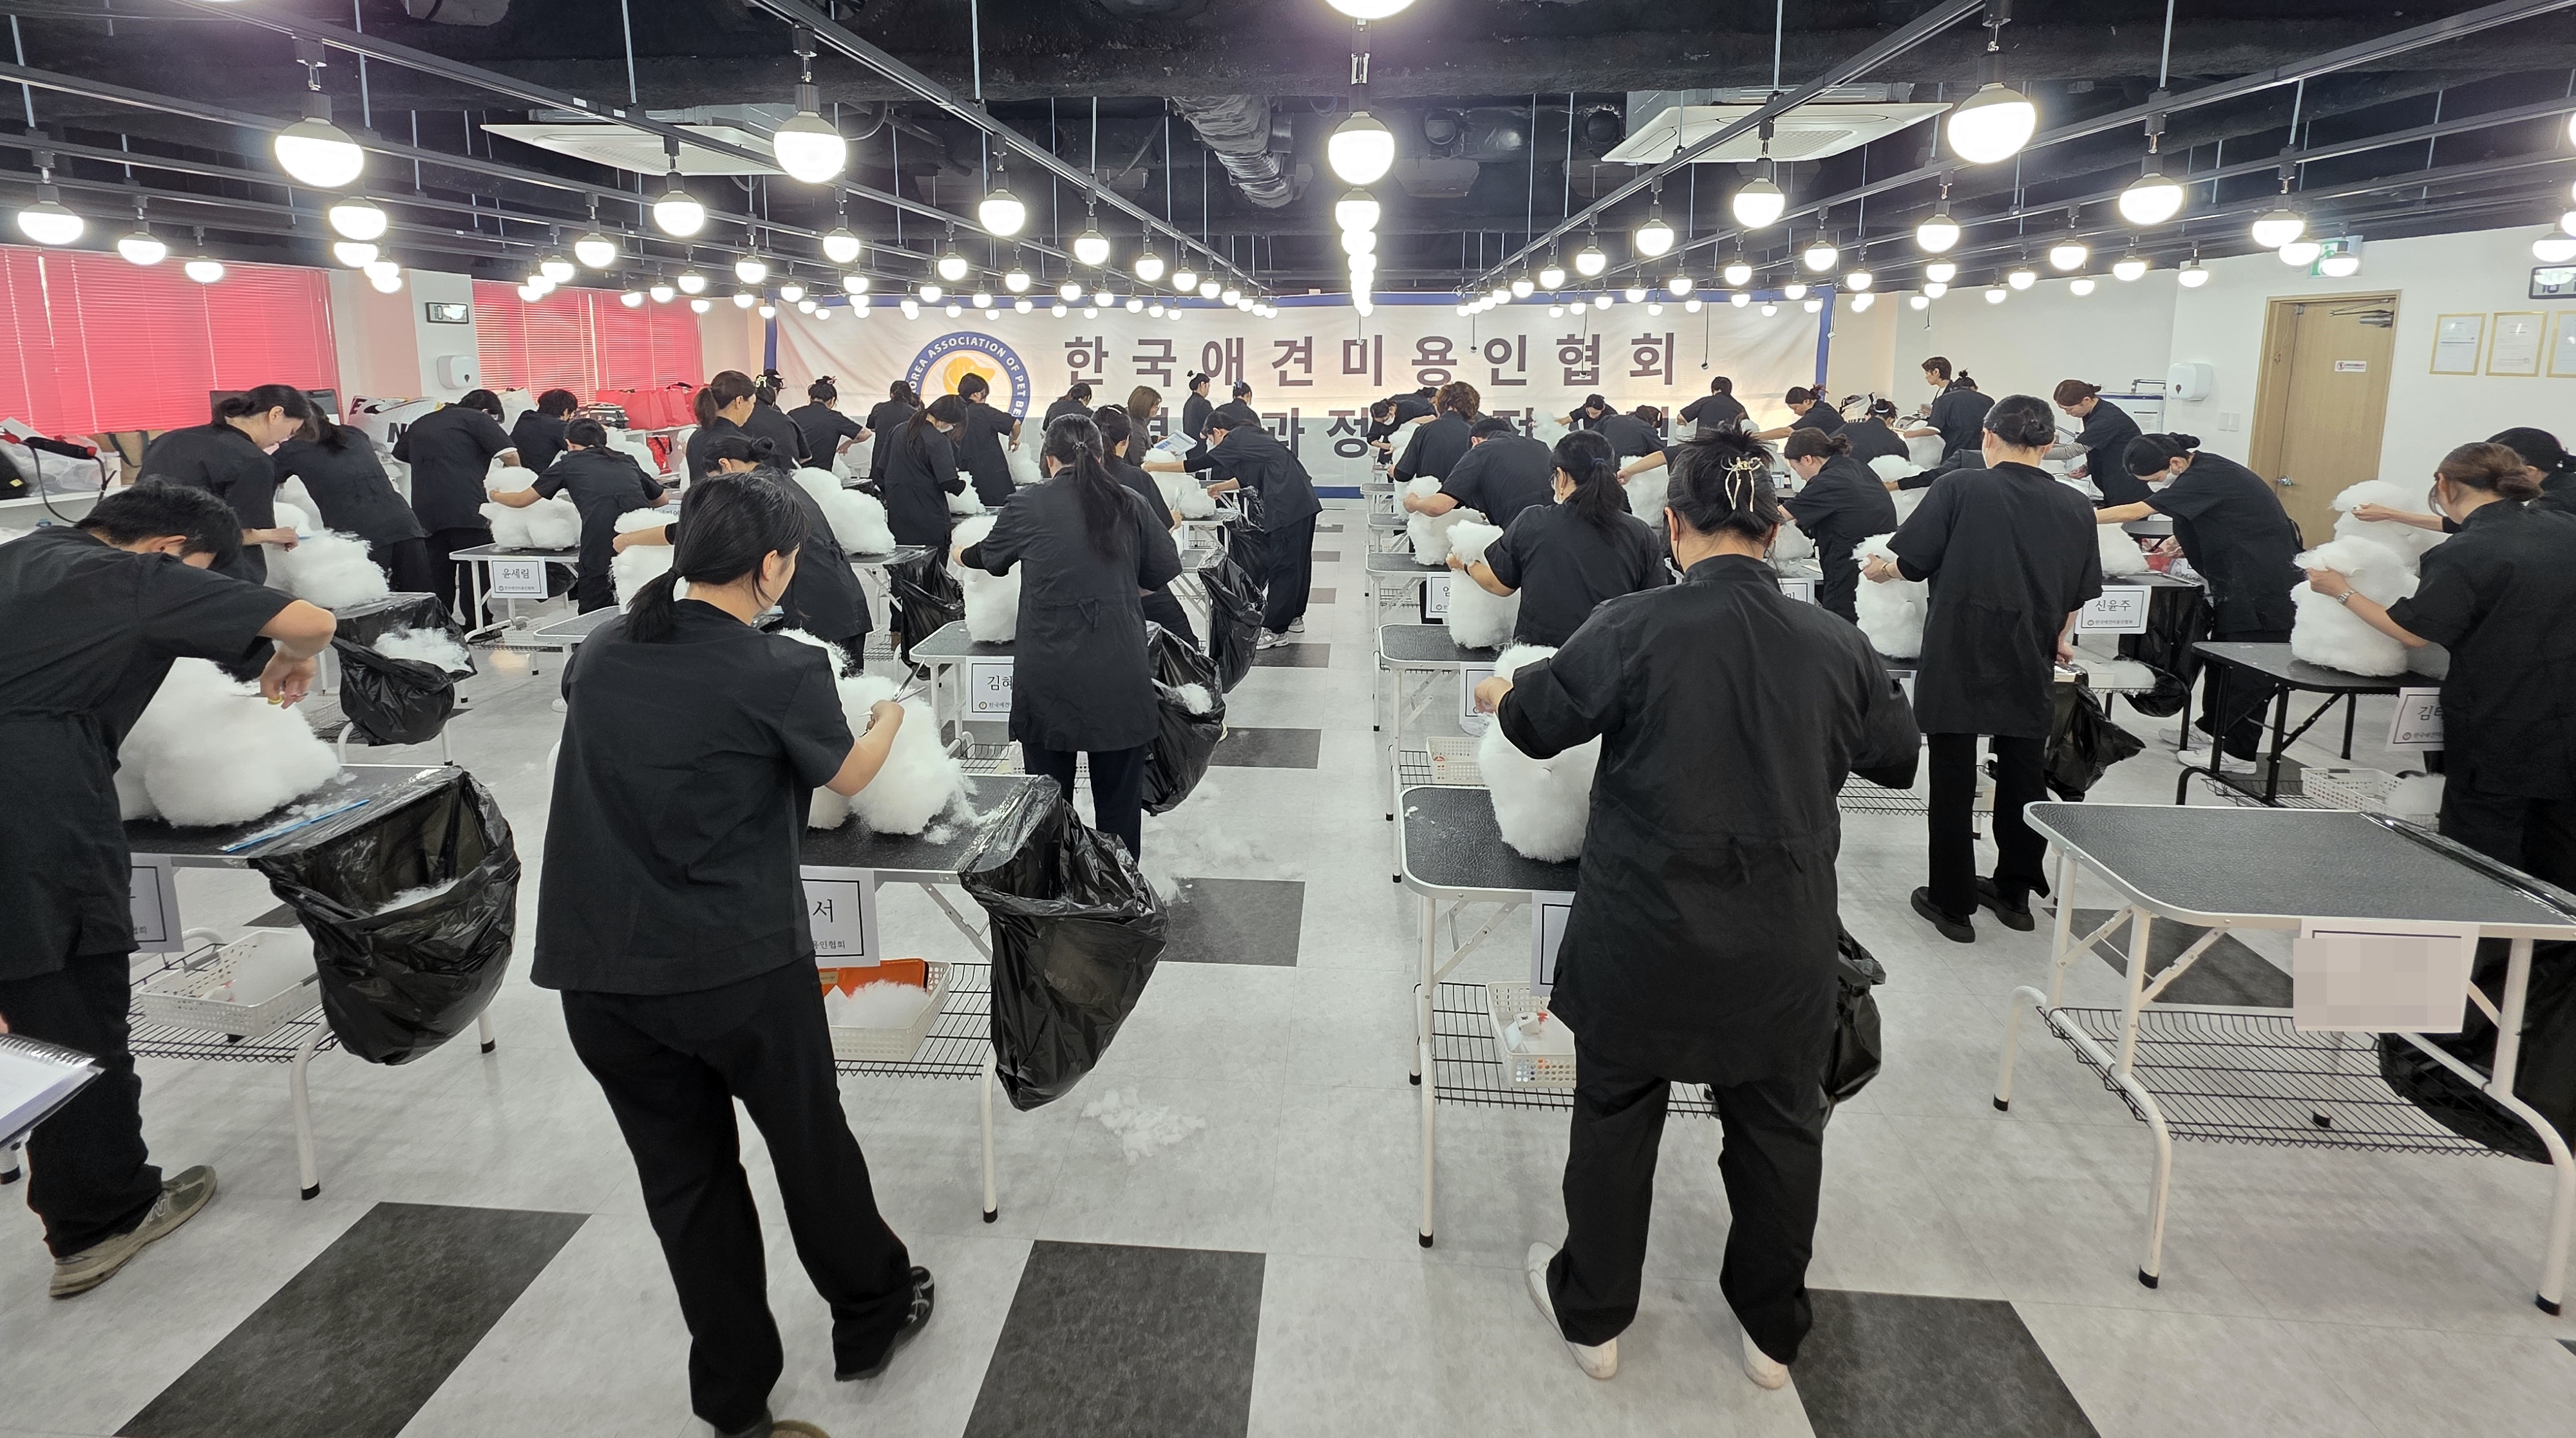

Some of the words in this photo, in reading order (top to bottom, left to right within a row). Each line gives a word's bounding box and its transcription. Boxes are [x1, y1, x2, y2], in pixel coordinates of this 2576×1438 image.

[909, 358, 928, 393] OREA
[927, 336, 1006, 358] ASSOCIATION
[1006, 357, 1020, 372] OF
[1015, 375, 1026, 397] PET
[1065, 332, 1674, 387] 한국애견미용인협회
[502, 568, 529, 579] 윤세림
[2096, 600, 2131, 612] 신윤주
